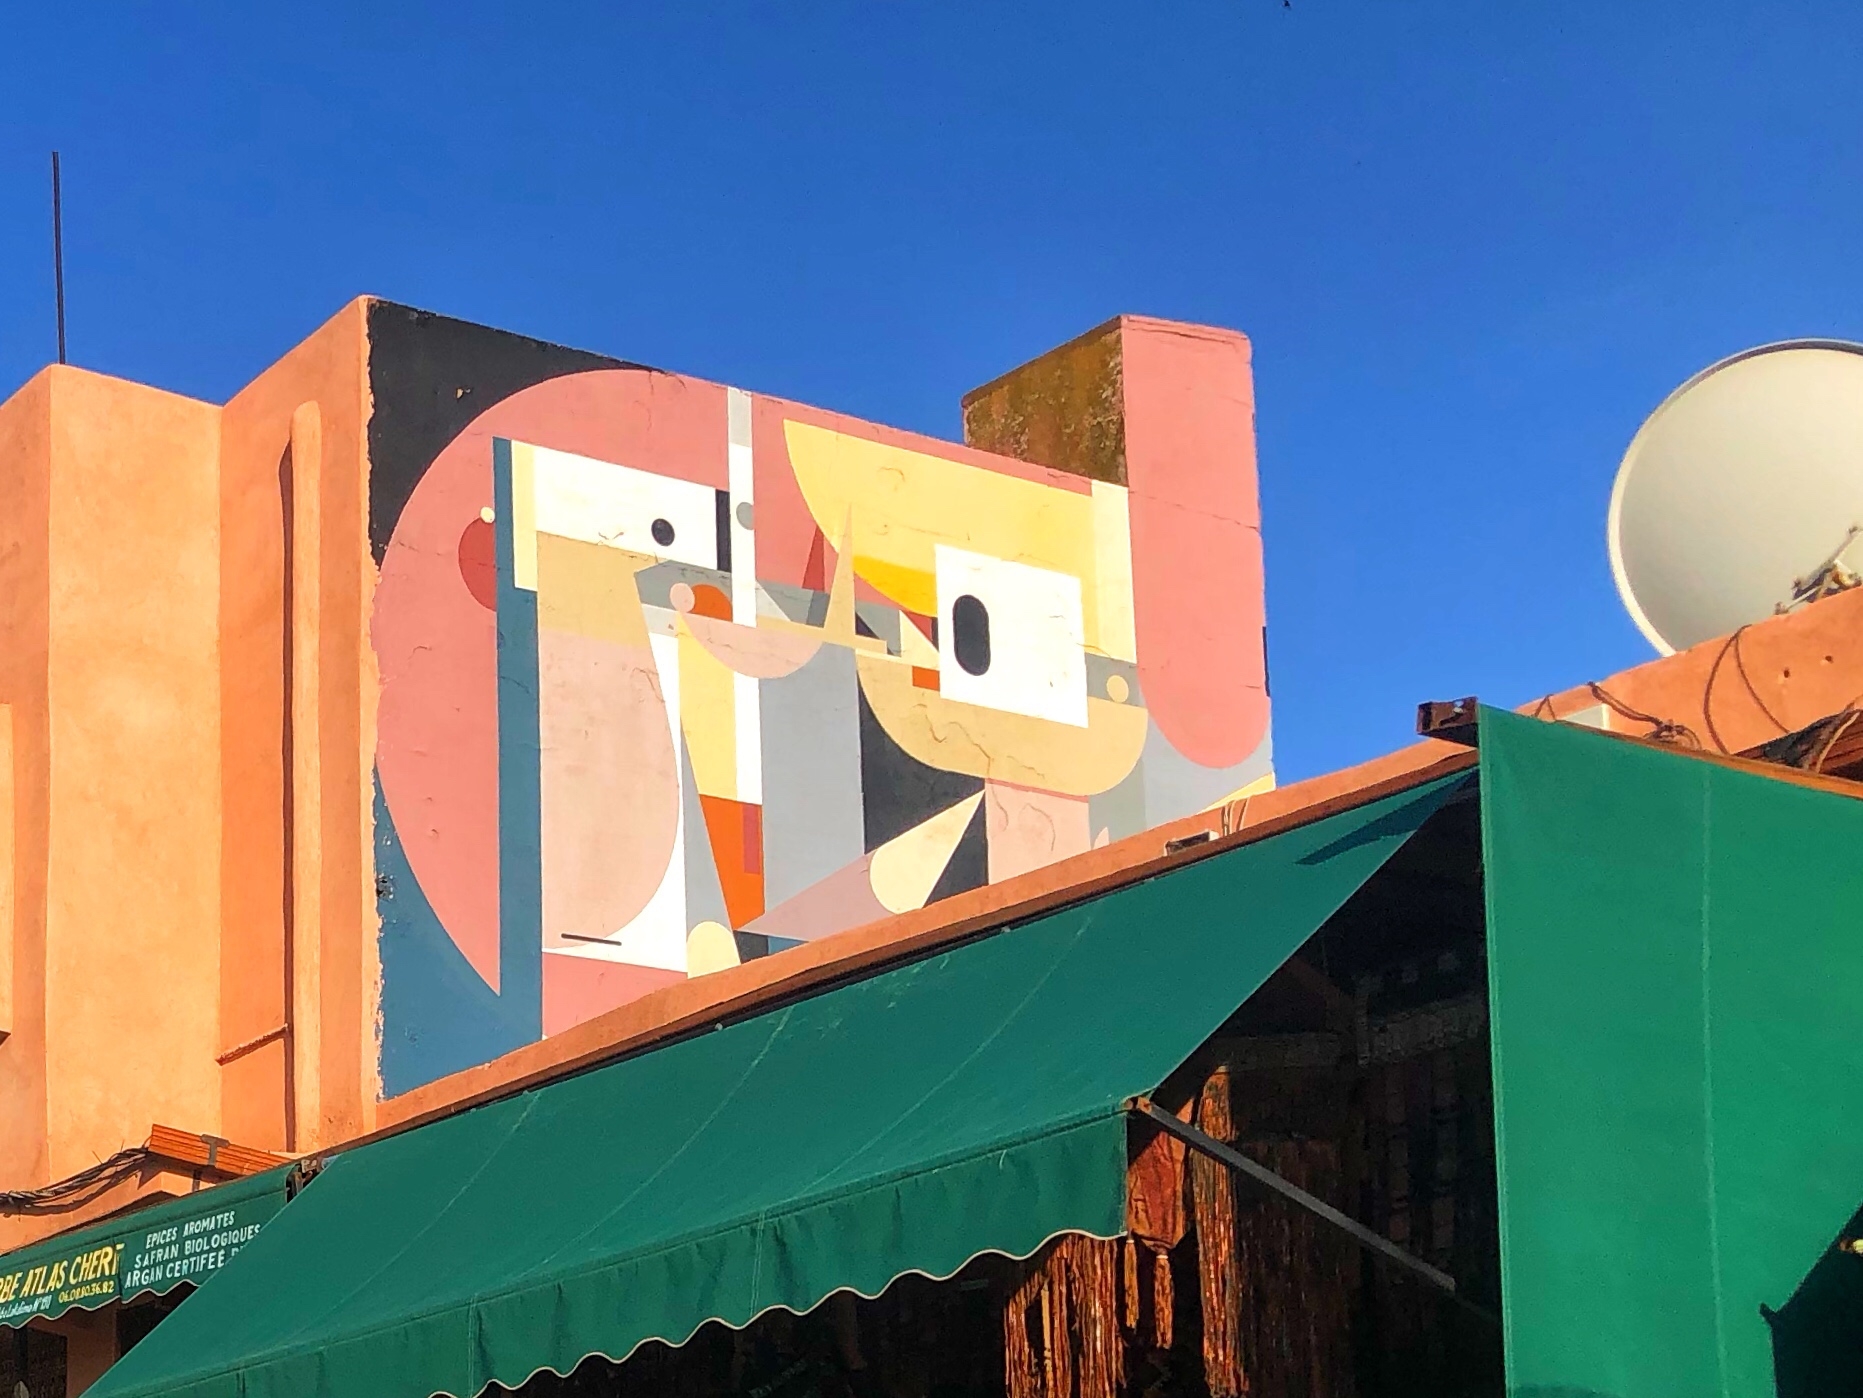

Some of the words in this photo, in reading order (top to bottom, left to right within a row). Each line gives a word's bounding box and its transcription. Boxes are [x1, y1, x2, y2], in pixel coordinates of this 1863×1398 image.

[134, 1243, 179, 1269] SAFRAN
[184, 1224, 261, 1255] BIOLOGIQUES
[146, 1227, 178, 1249] EPICES
[182, 1210, 235, 1237] AROMATES
[19, 1260, 68, 1299] ATLAS
[124, 1264, 164, 1289] ARGAN
